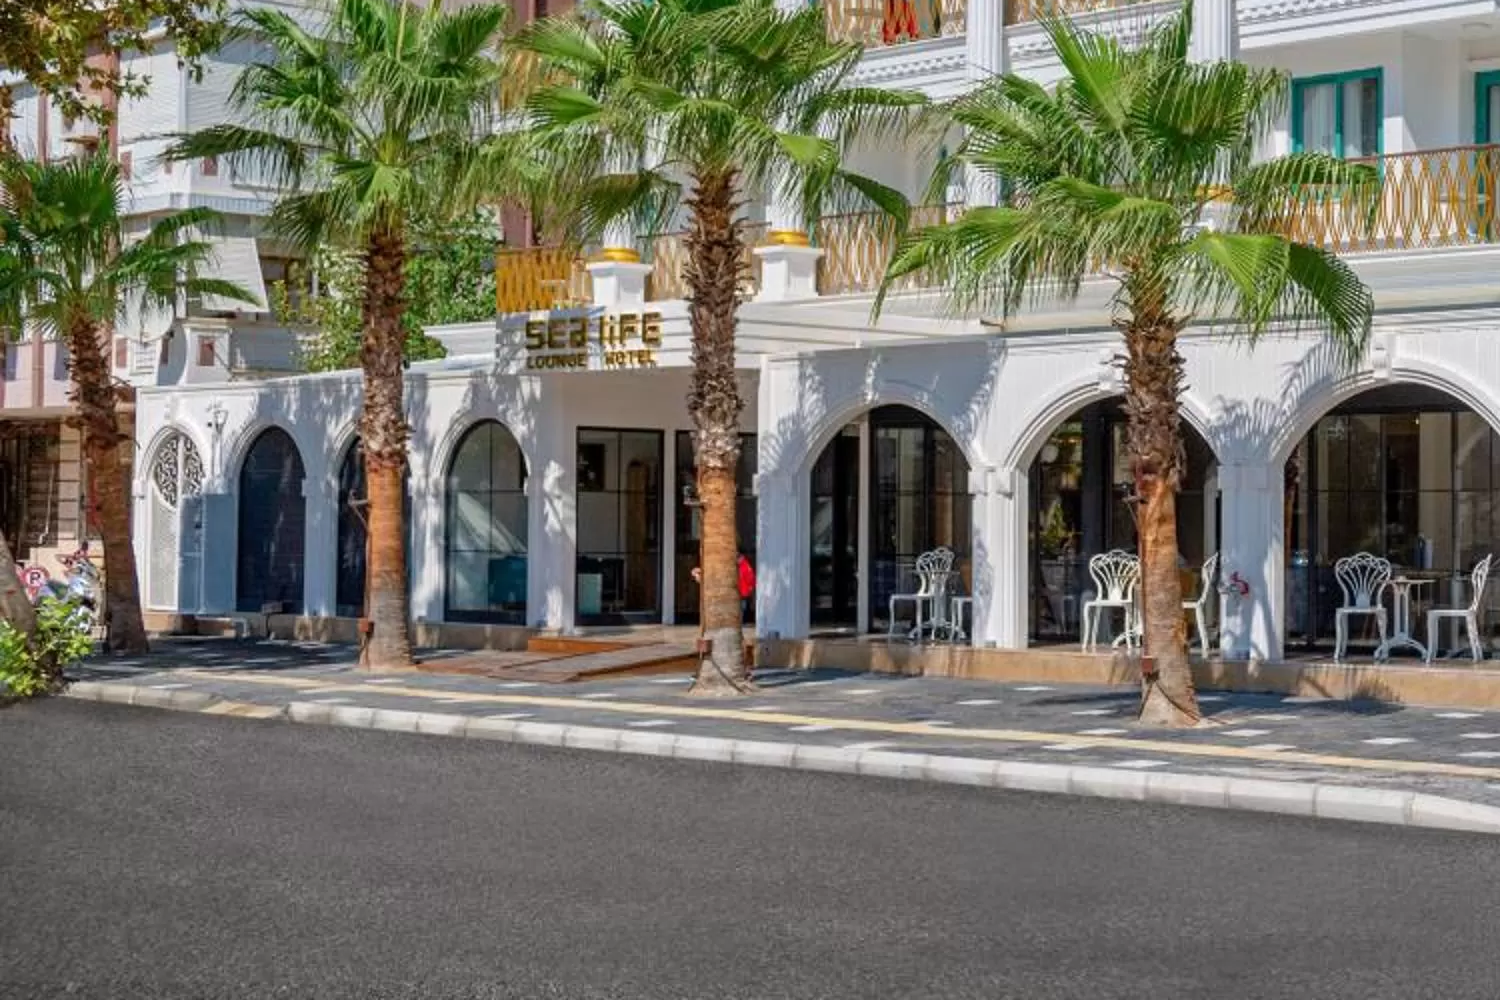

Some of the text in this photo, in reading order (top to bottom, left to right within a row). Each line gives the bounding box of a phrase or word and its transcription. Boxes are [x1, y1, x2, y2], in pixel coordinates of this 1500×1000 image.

[526, 349, 656, 369] LOUNGE HOTEL
[29, 571, 41, 585] P
